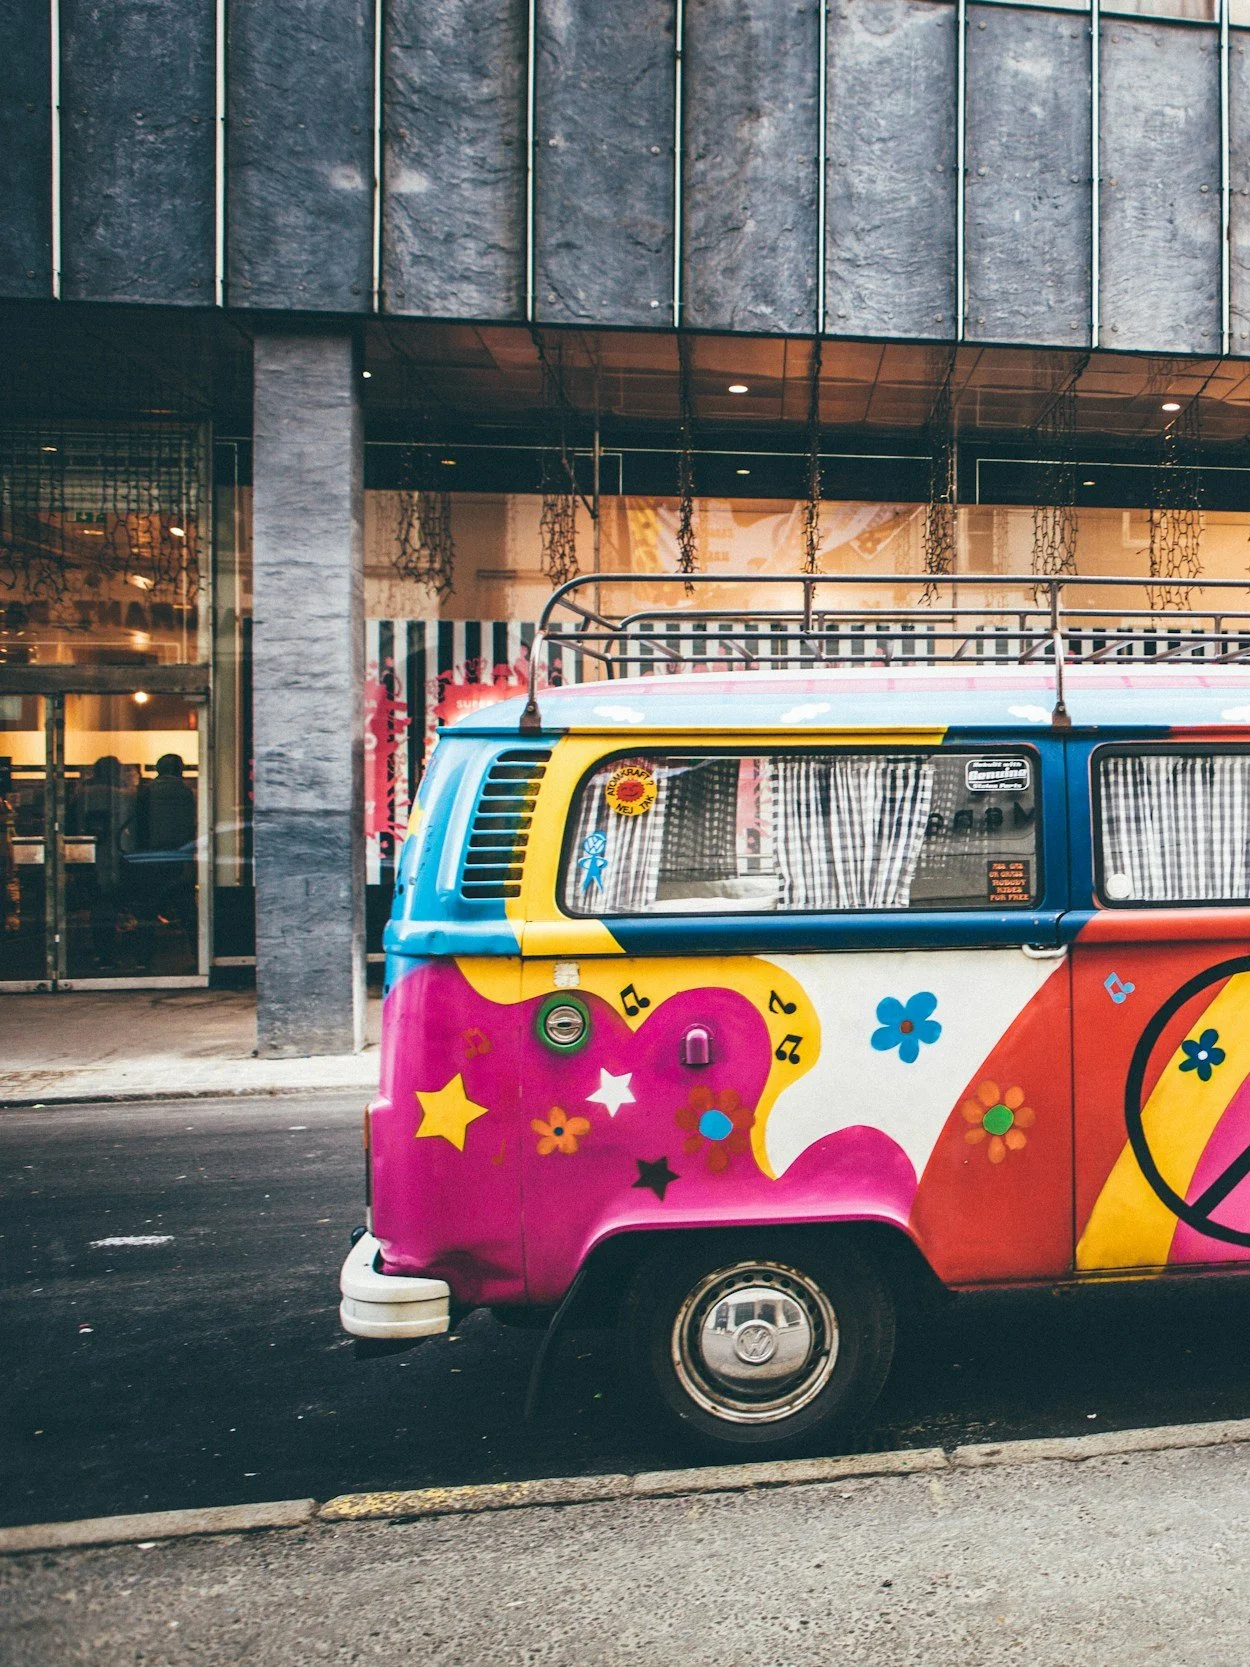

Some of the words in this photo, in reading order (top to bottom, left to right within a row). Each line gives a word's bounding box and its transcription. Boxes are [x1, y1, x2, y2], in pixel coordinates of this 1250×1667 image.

[968, 767, 1028, 781] Genuine
[616, 802, 634, 815] NEJ
[639, 795, 655, 810] TAK
[741, 1327, 773, 1357] VW
